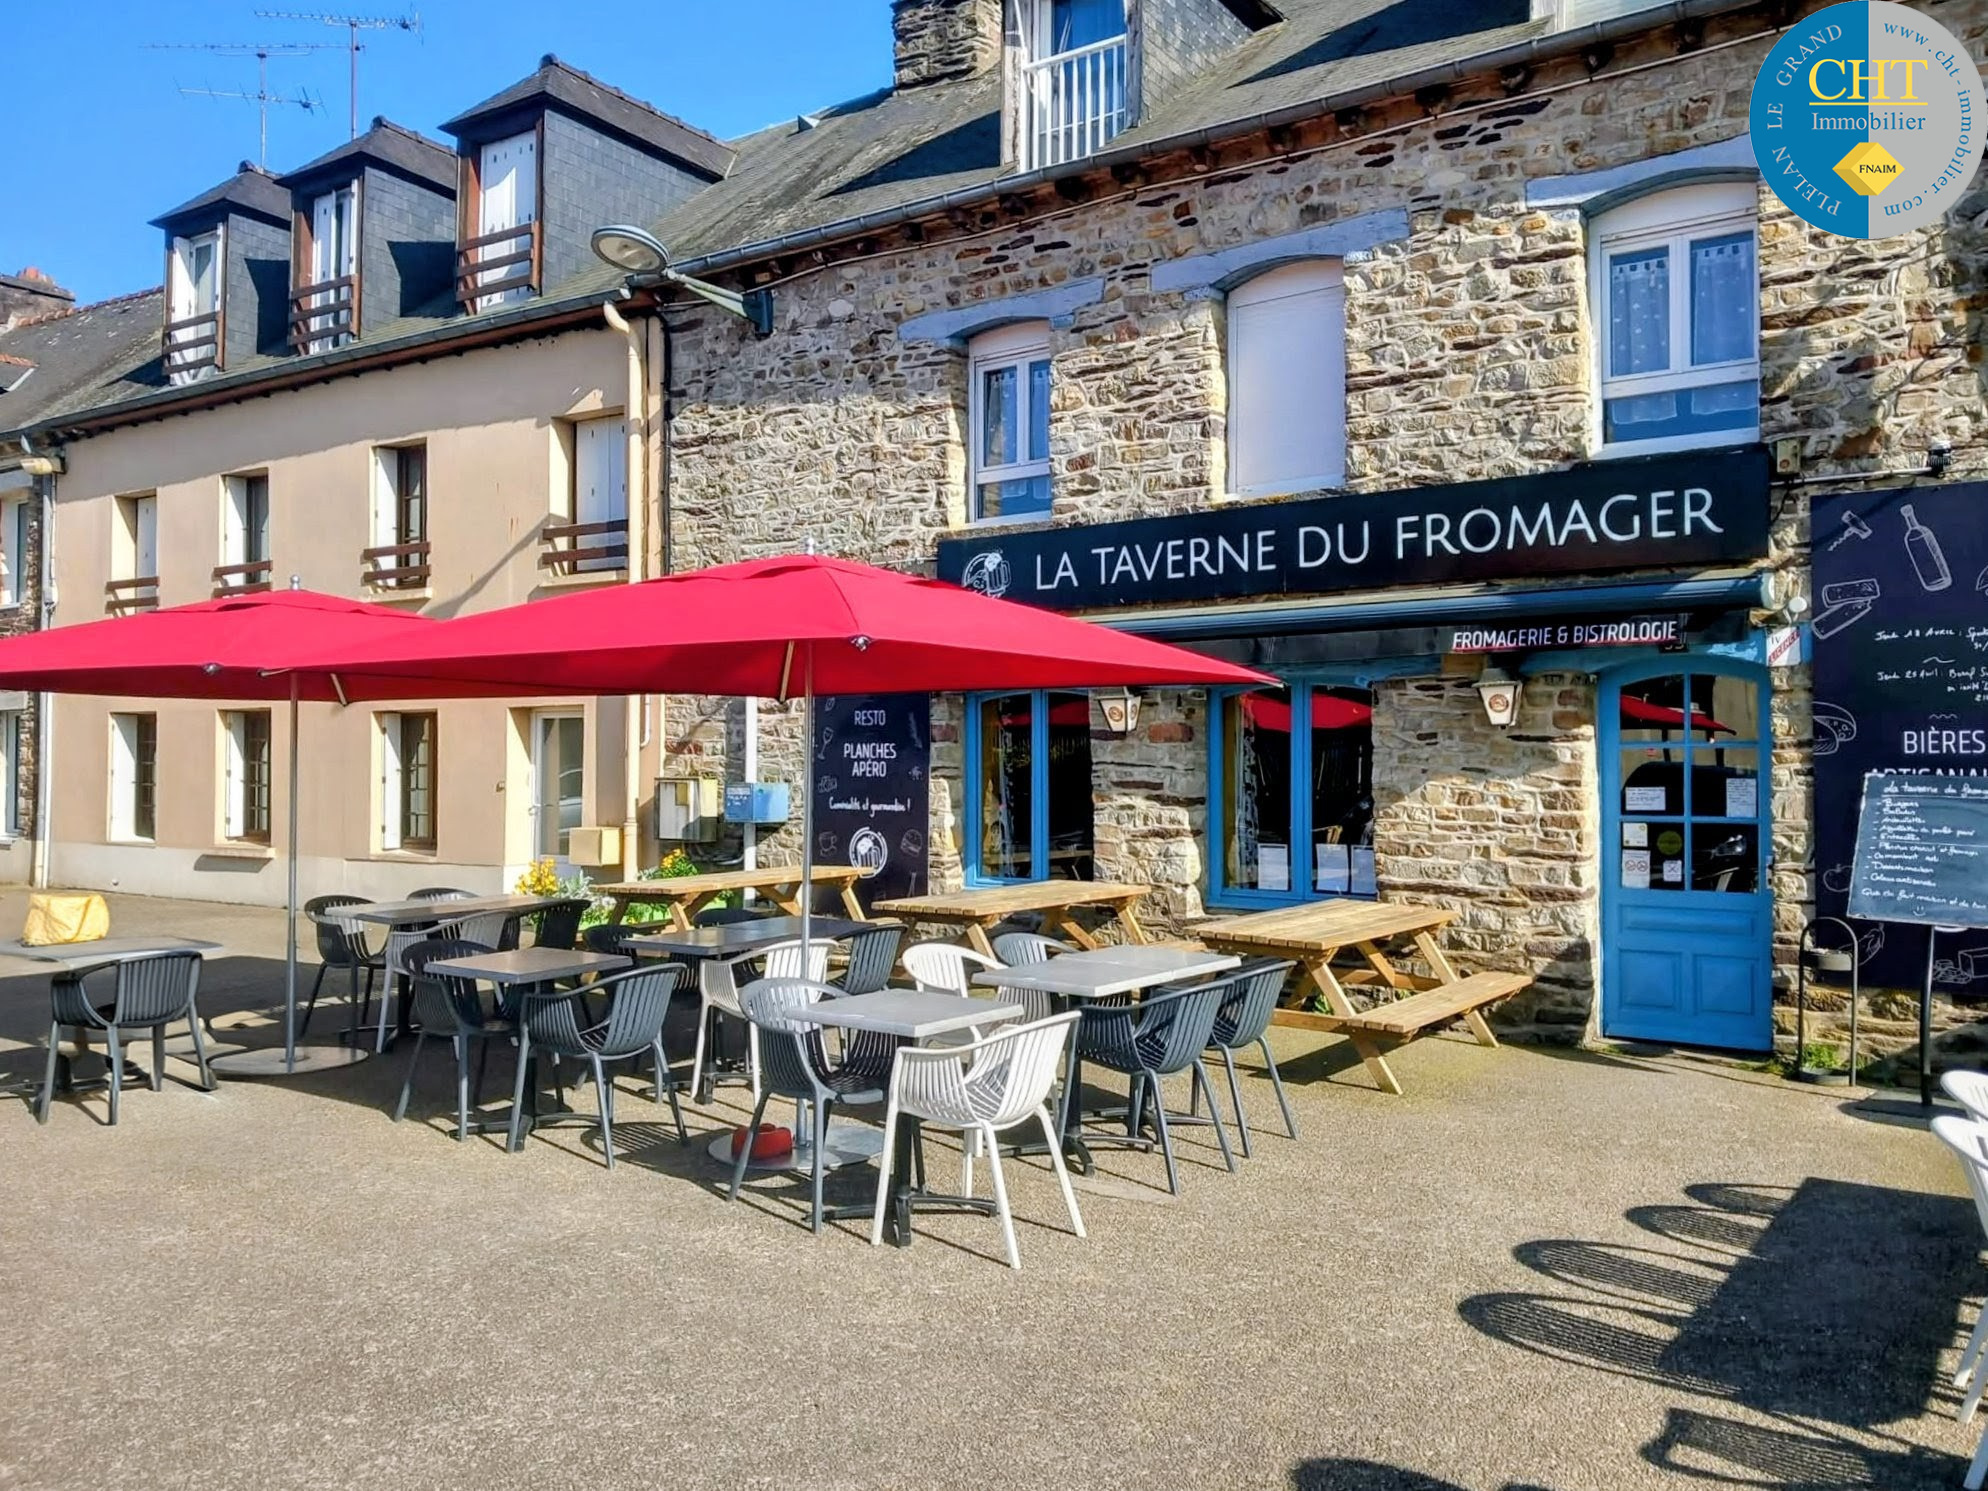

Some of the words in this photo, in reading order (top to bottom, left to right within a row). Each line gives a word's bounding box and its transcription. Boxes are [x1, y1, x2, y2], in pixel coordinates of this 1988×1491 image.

[1036, 552, 1079, 591] LA
[1091, 530, 1277, 585] TAVERNE
[1298, 520, 1370, 568] DU
[1396, 488, 1724, 560] FROMAGER
[1452, 627, 1553, 650] FROMAGERIE
[1557, 626, 1569, 643] &
[1572, 621, 1678, 643] BISTROLOGIE
[854, 710, 886, 726] RESTO
[843, 743, 897, 759] PLANCHES
[1903, 727, 1986, 754] BIÈRES
[852, 759, 887, 777] APÉRO
